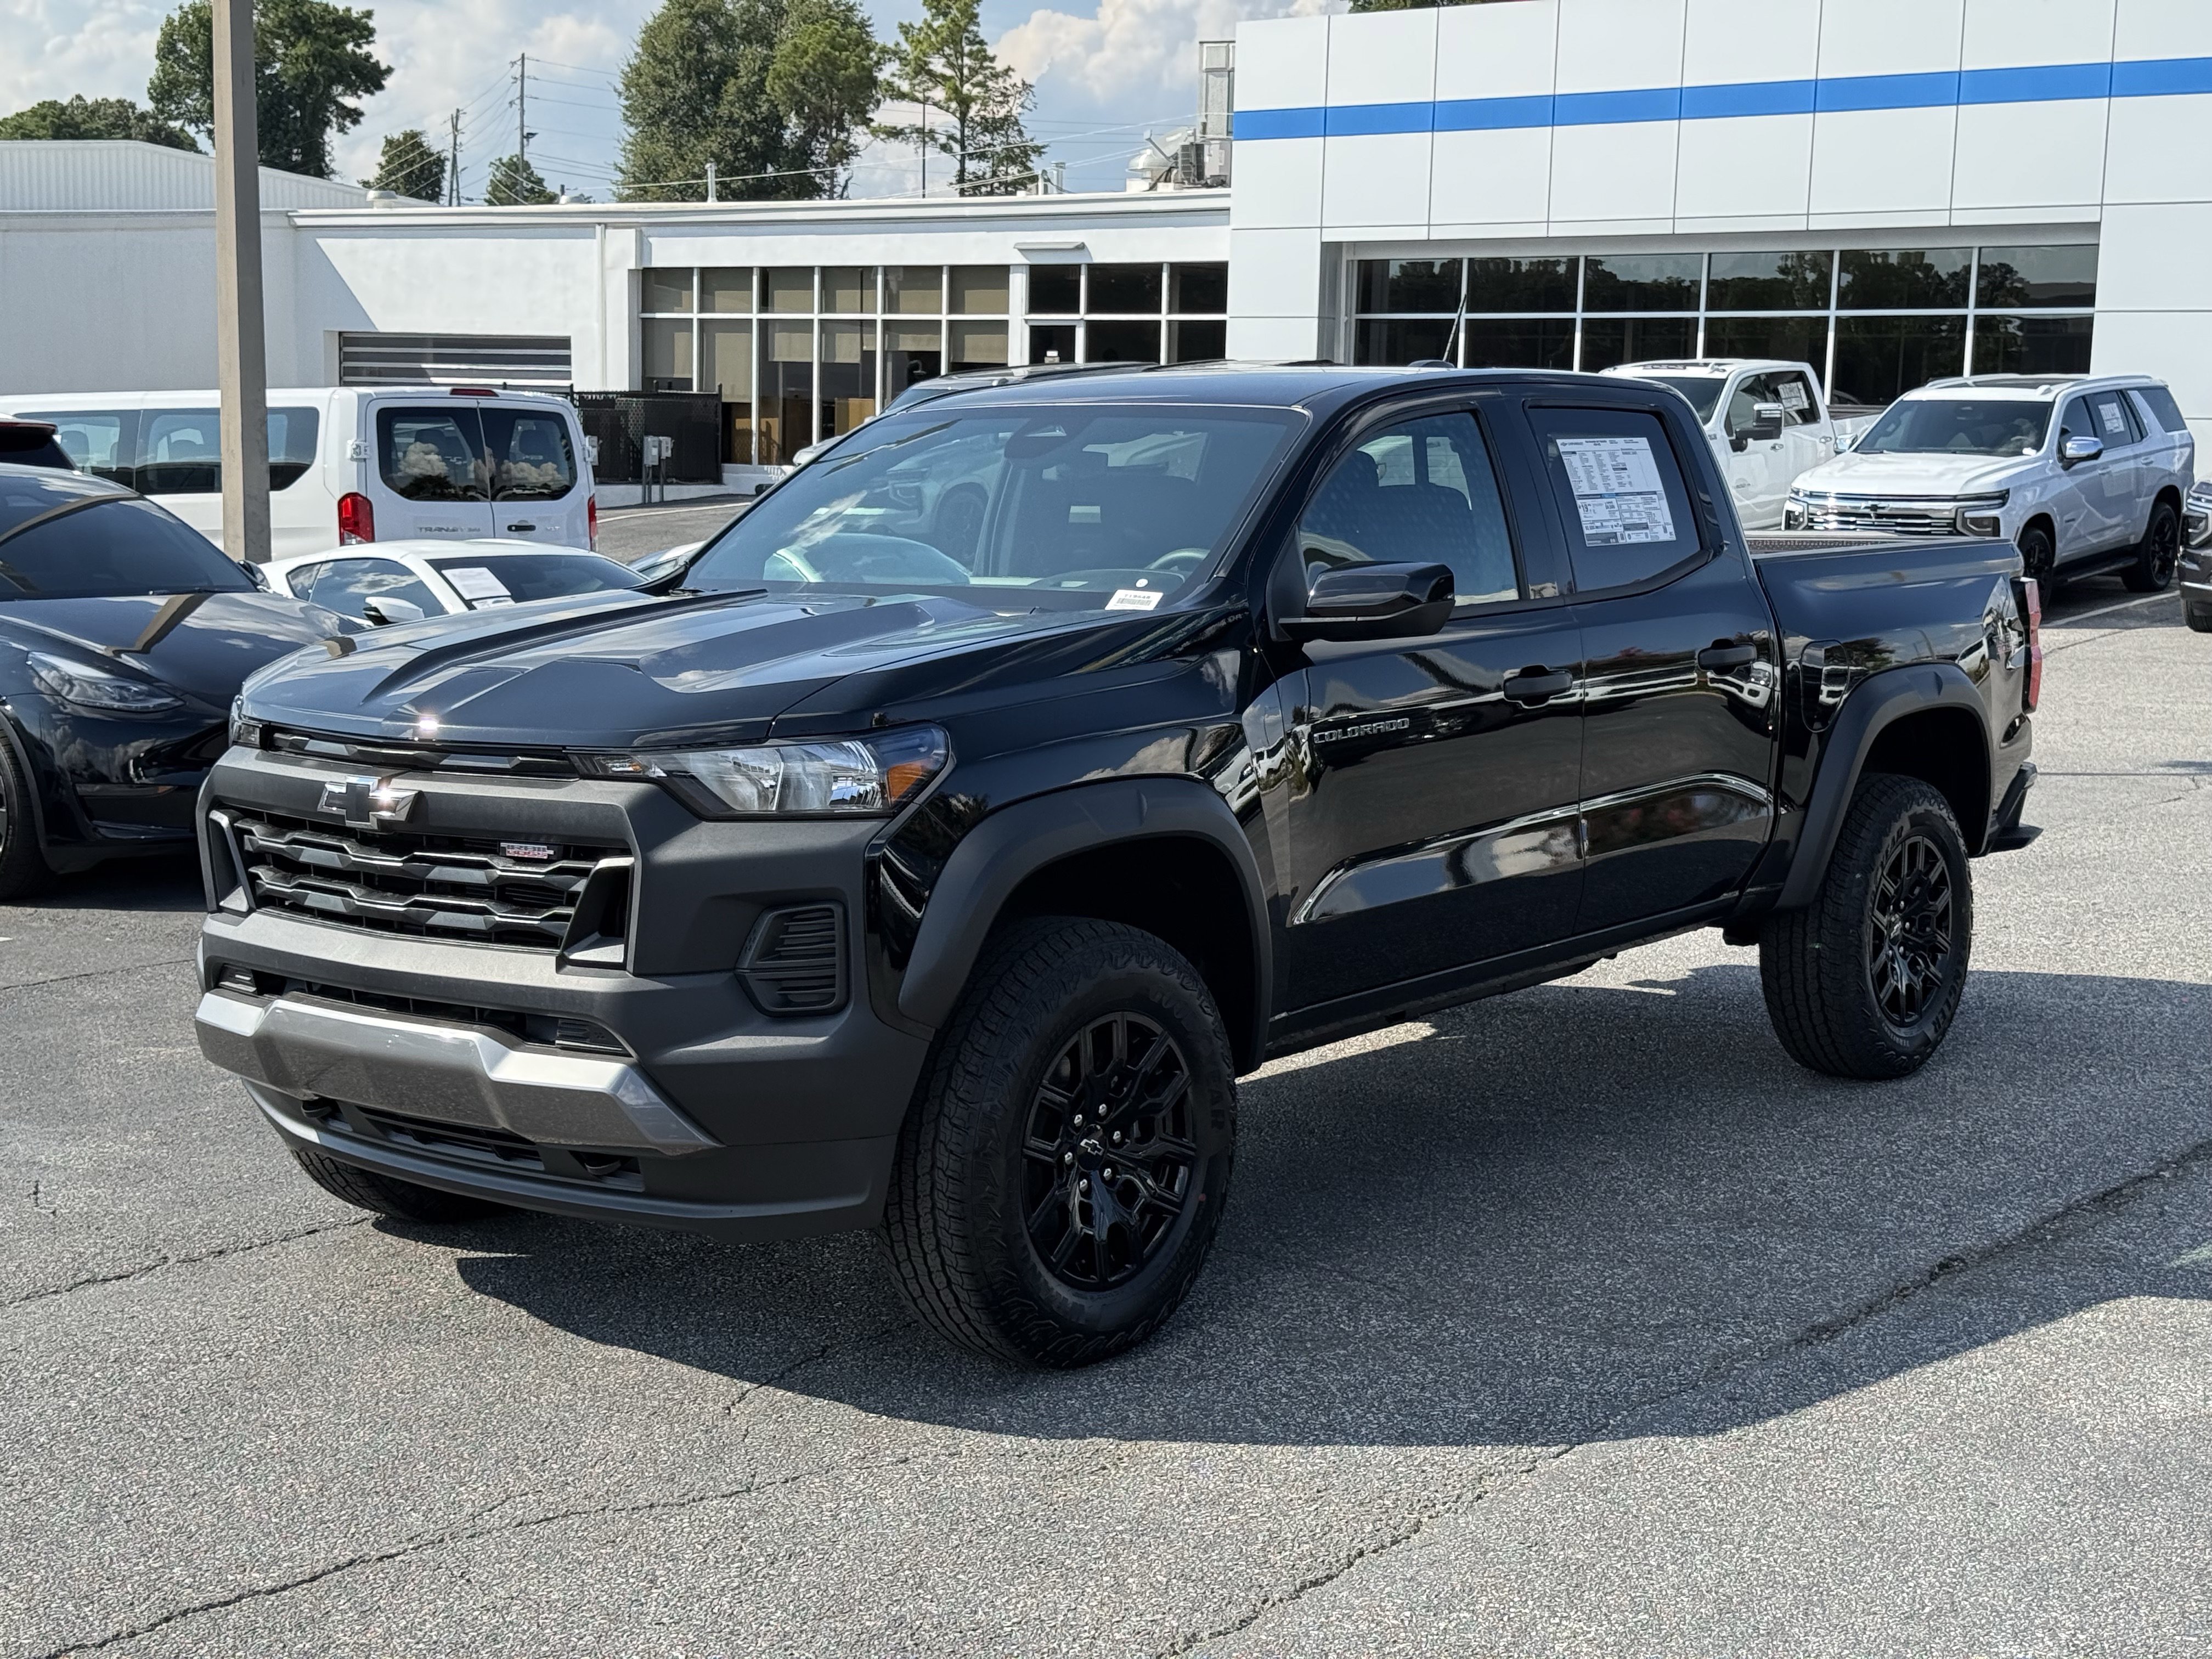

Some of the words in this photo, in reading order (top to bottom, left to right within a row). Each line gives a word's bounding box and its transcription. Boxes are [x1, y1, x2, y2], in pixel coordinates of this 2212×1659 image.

[1313, 718, 1410, 743] COLORADO
[500, 843, 554, 855] TRAIL
[1149, 986, 1225, 1131] GOODEAR
